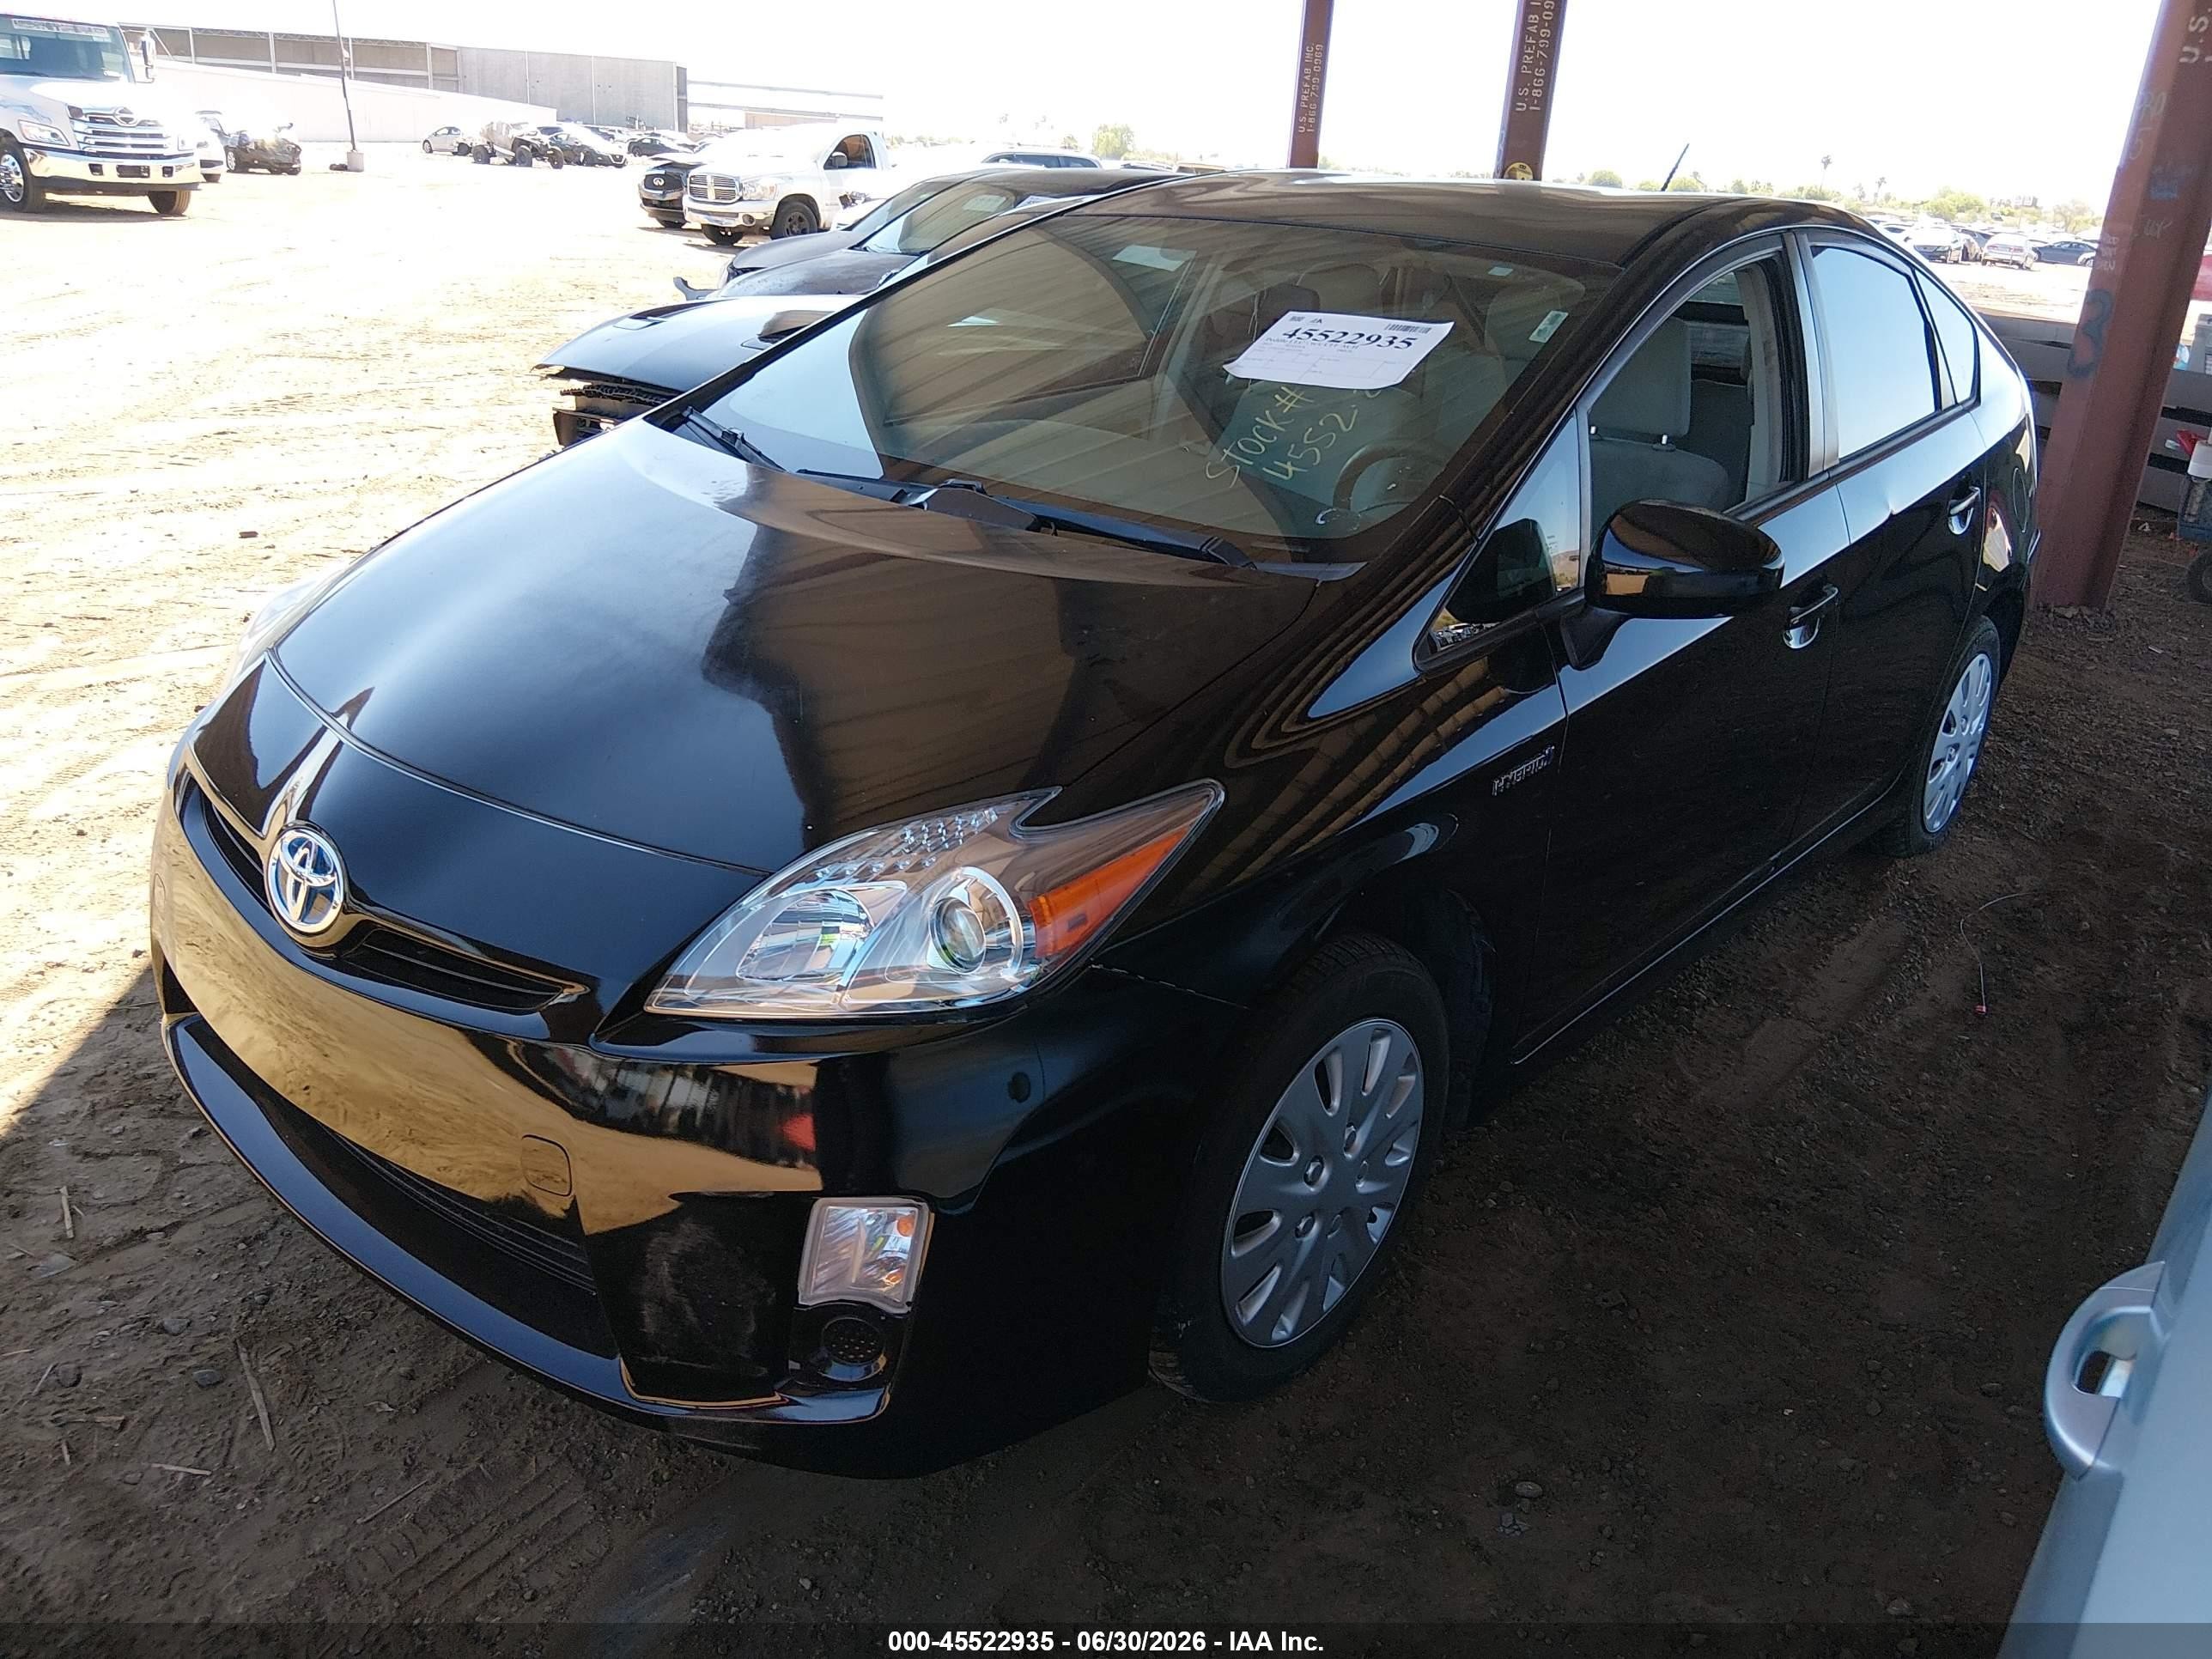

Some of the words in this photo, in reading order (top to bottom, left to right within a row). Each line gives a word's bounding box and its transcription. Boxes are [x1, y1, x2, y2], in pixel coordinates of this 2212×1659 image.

[1304, 43, 1315, 63] INC.
[1521, 14, 1540, 74] PREFAB
[1300, 68, 1312, 108] PREFAB
[1515, 83, 1530, 112] U.S.
[1298, 112, 1308, 133] U.S.
[1282, 326, 1419, 351] 45522935
